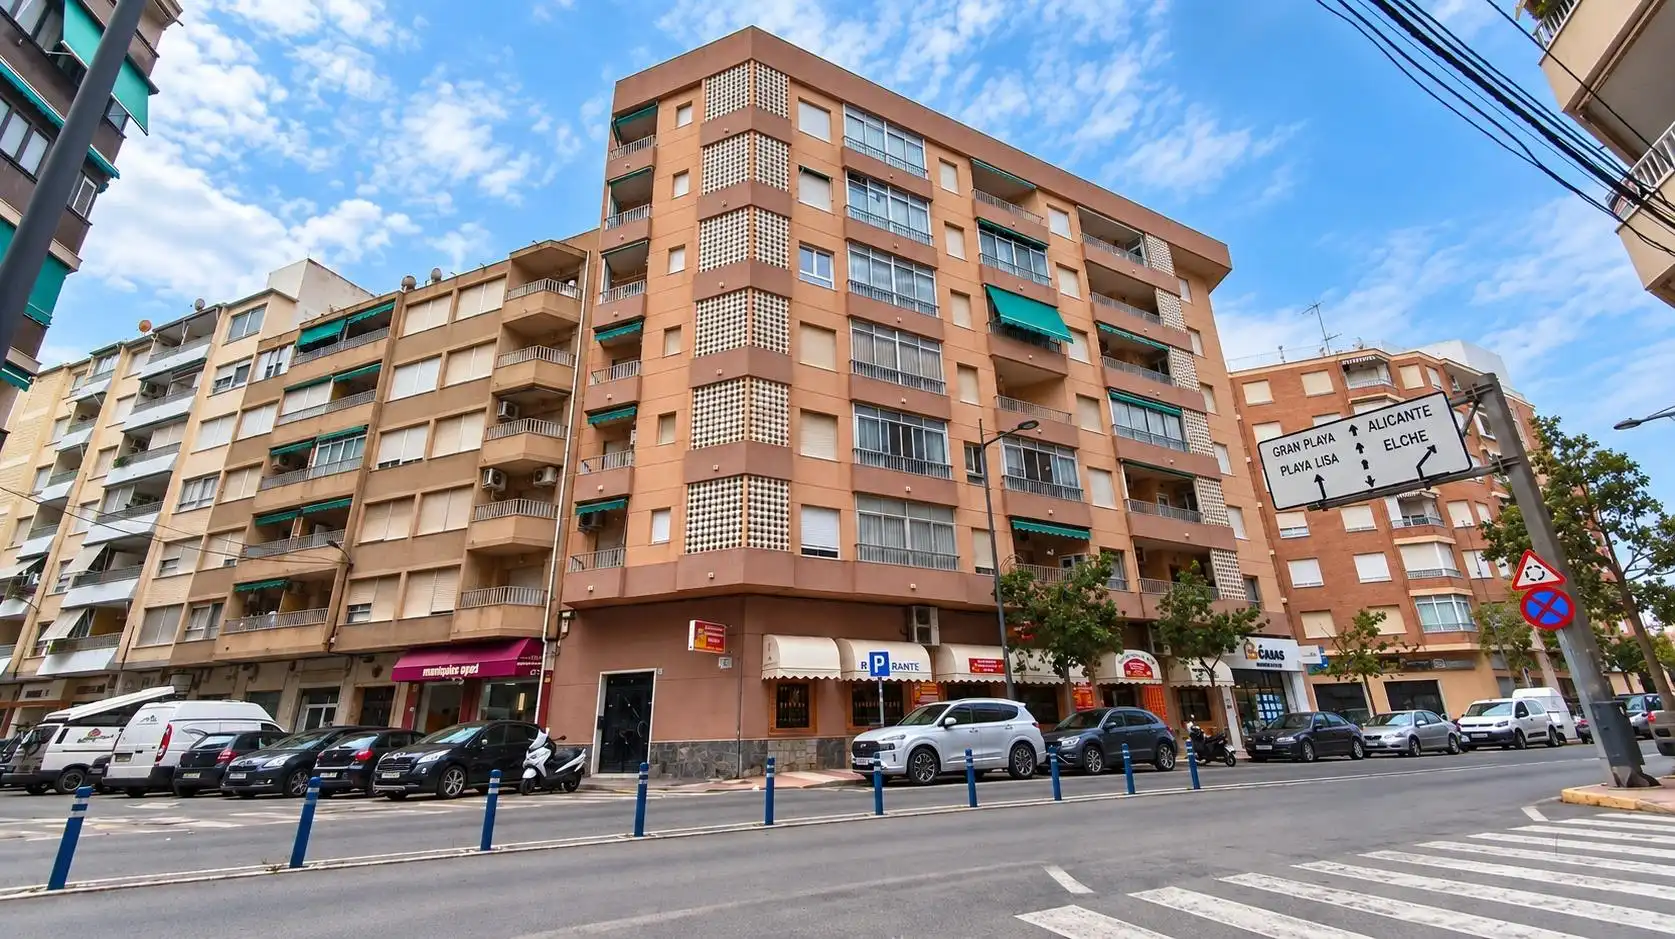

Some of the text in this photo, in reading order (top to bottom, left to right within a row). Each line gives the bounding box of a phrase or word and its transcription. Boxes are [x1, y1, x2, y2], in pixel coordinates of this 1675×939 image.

[1368, 405, 1432, 432] ALICANTE
[1272, 432, 1336, 458] GRAN PLAYA
[1384, 430, 1429, 452] ELCHE
[1280, 453, 1340, 477] PLAYA LISA
[873, 655, 885, 673] P
